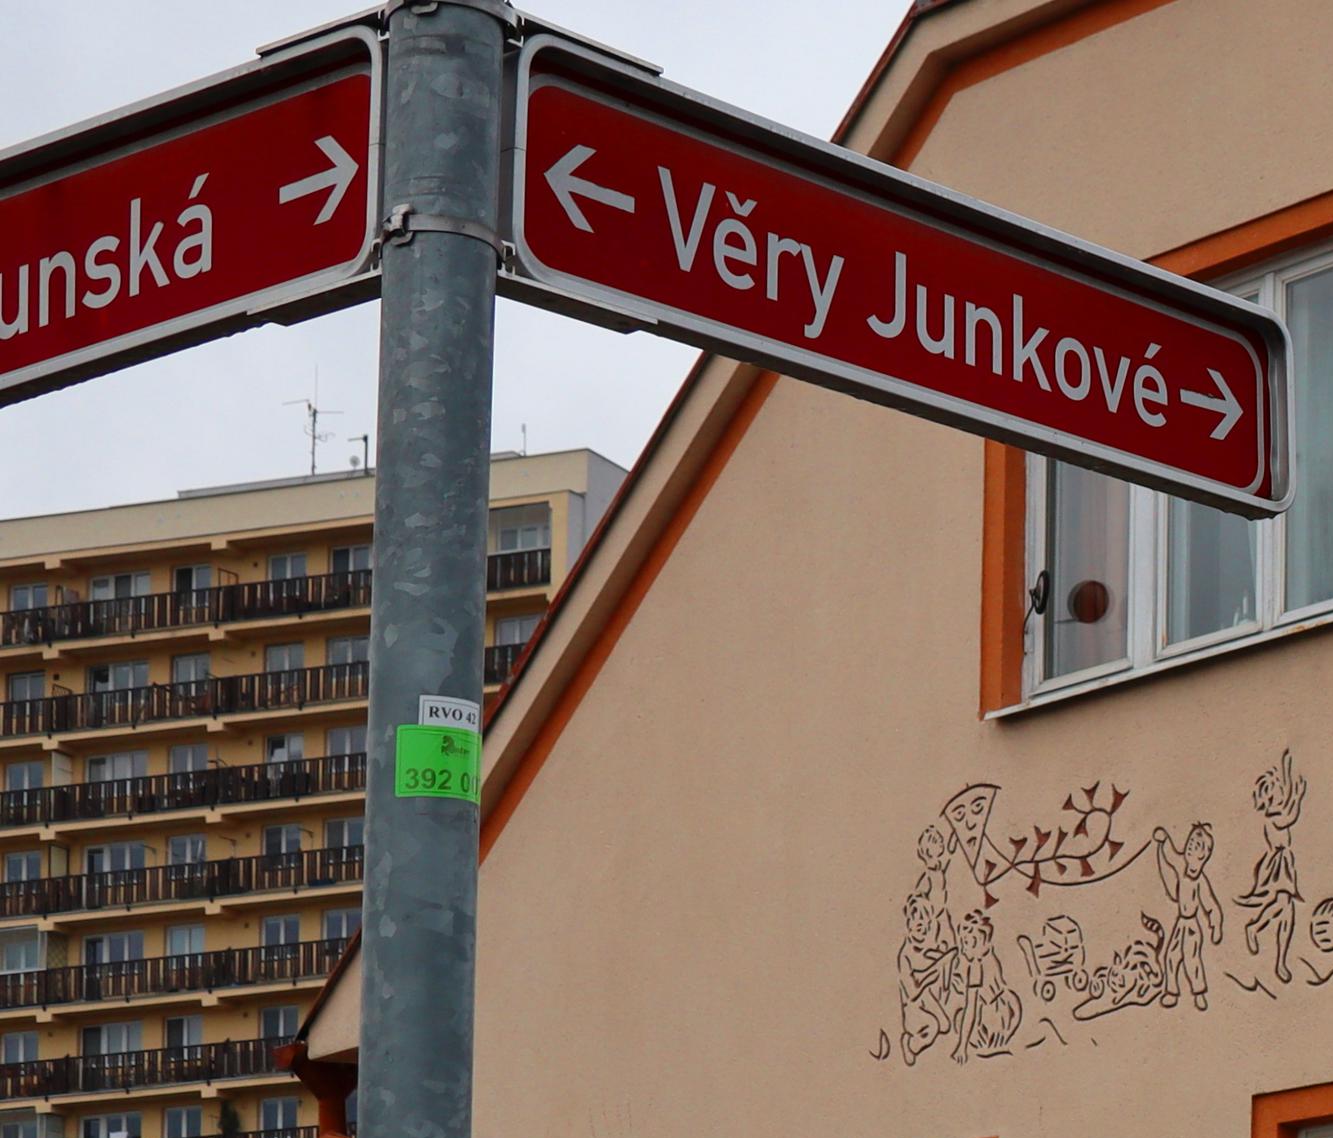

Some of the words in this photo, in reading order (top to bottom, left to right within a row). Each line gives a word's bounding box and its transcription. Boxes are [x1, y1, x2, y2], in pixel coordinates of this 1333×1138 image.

[657, 165, 845, 338] Věry
[866, 252, 1169, 427] Junkové
[428, 706, 463, 721] RVO
[405, 768, 452, 790] 392
